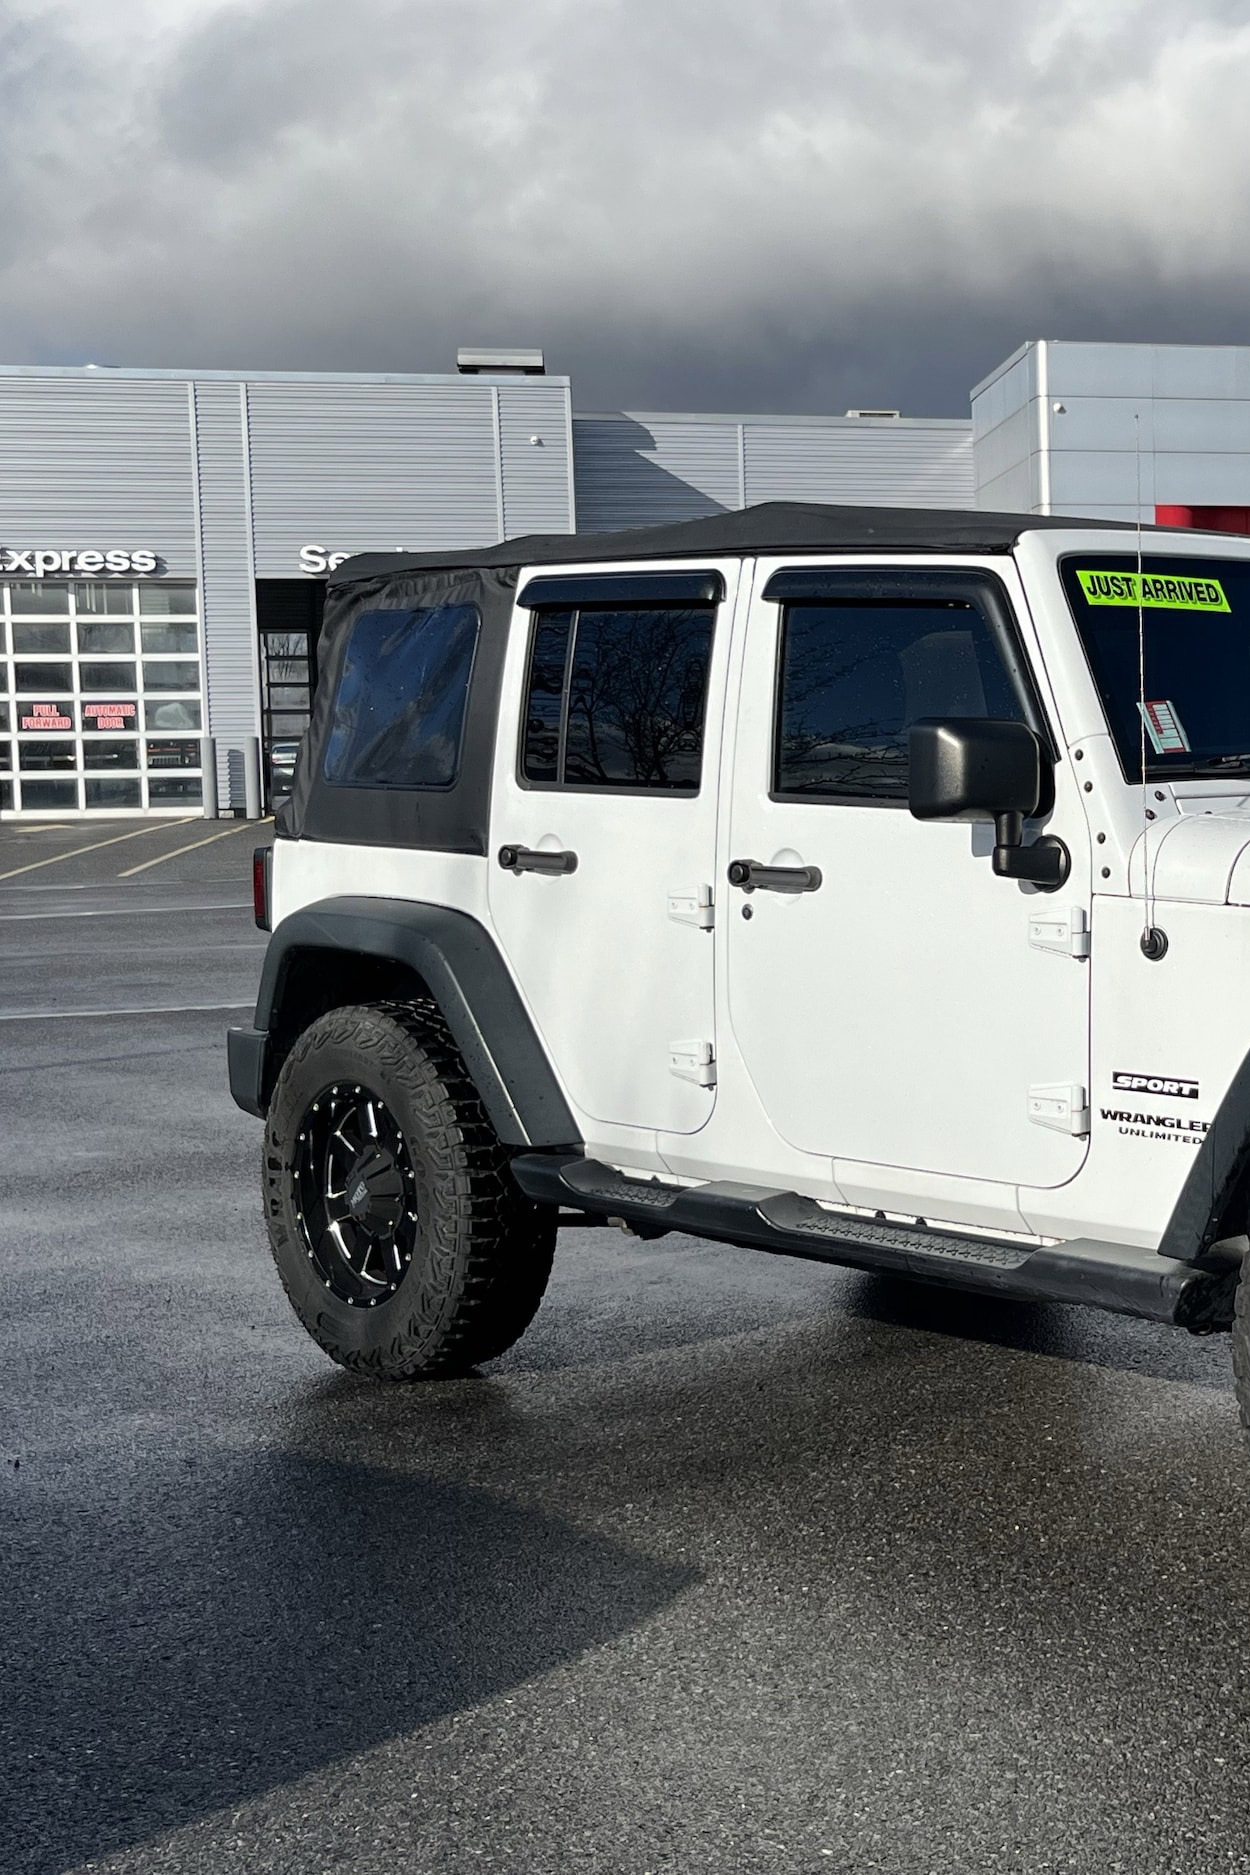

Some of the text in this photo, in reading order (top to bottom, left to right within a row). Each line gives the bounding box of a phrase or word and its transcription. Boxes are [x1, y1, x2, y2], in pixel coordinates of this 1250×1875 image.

[0, 549, 156, 577] xpress
[1086, 575, 1221, 603] JUST ARRIVED
[33, 704, 59, 716] PULL
[84, 704, 136, 717] AUTOMATIC
[22, 716, 71, 729] FORWARD
[97, 717, 125, 729] DOOR
[1115, 1075, 1199, 1096] SPORT
[1118, 1126, 1203, 1145] UNLIMITED
